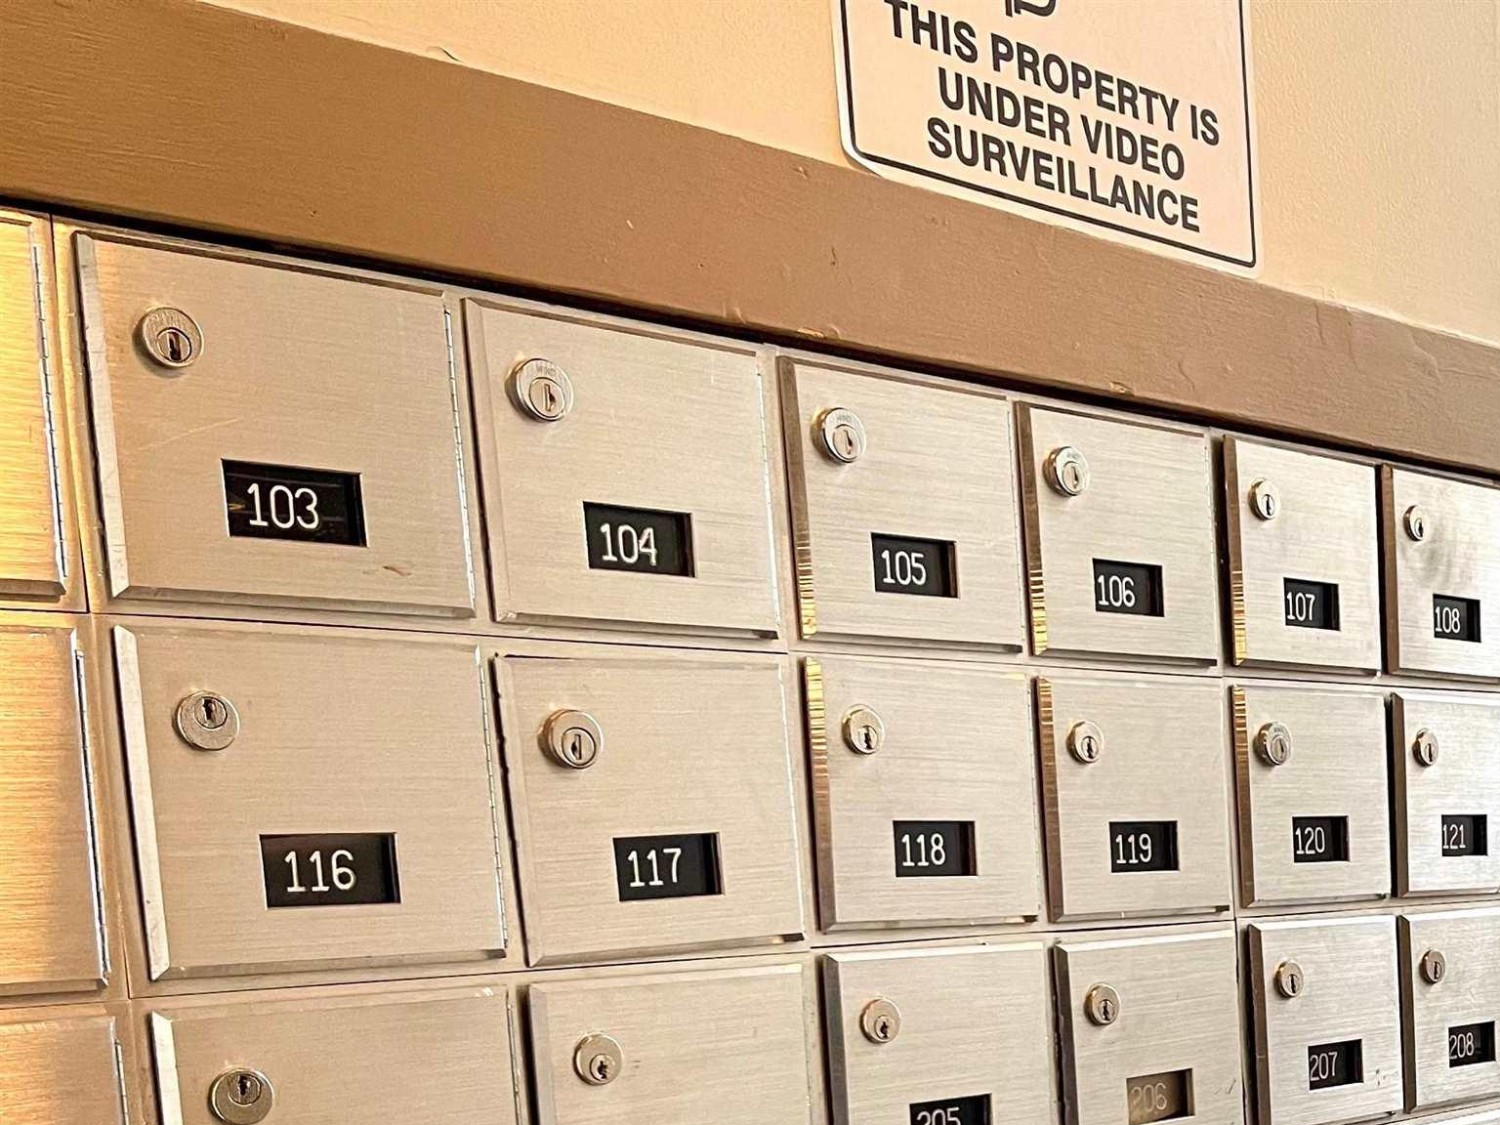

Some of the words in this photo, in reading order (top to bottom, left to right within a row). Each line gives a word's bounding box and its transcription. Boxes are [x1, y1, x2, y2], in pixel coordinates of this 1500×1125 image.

[884, 0, 979, 64] THIS
[990, 33, 1181, 131] PROPERTY
[1190, 104, 1220, 147] IS
[938, 66, 1071, 147] UNDER
[1080, 114, 1185, 181] VIDEO
[927, 117, 1200, 233] SURVEILLANCE
[248, 483, 320, 529] 103
[600, 522, 657, 566] 104
[881, 549, 926, 585] 105
[1098, 575, 1135, 607] 106
[1286, 592, 1315, 621] 107
[1435, 607, 1460, 633] 108
[902, 833, 946, 867] 118
[1115, 834, 1152, 864] 119
[1295, 827, 1325, 854] 120
[1443, 824, 1466, 849] 121
[284, 849, 356, 893] 116
[627, 848, 682, 887] 117
[1449, 1032, 1474, 1060] 208
[1309, 1051, 1338, 1081] 207
[1129, 1083, 1167, 1114] 206
